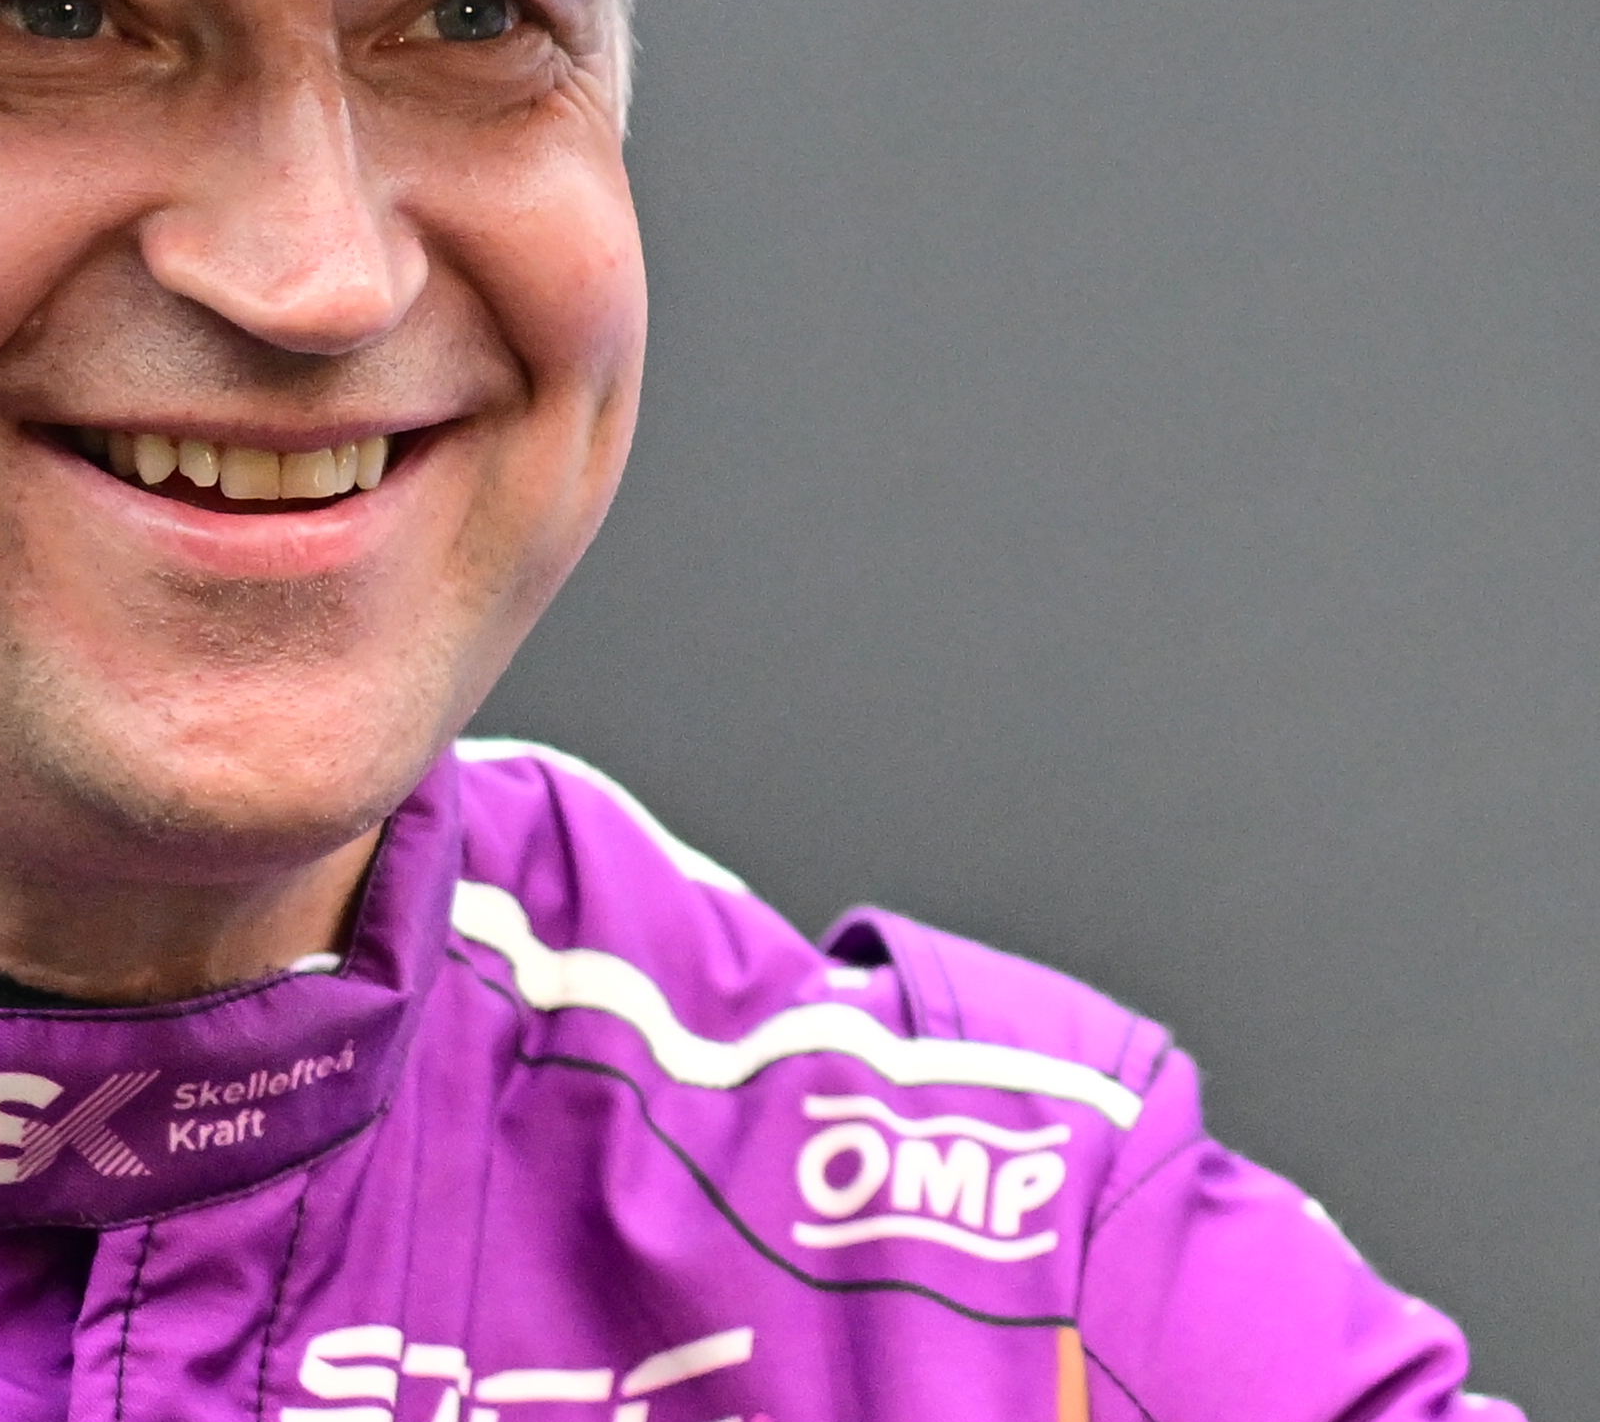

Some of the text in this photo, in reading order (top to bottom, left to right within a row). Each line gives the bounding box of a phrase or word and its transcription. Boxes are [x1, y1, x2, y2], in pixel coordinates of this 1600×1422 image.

[172, 1037, 356, 1111] Skellefteå
[166, 1108, 267, 1153] Kraft
[796, 1121, 1067, 1237] OMP
